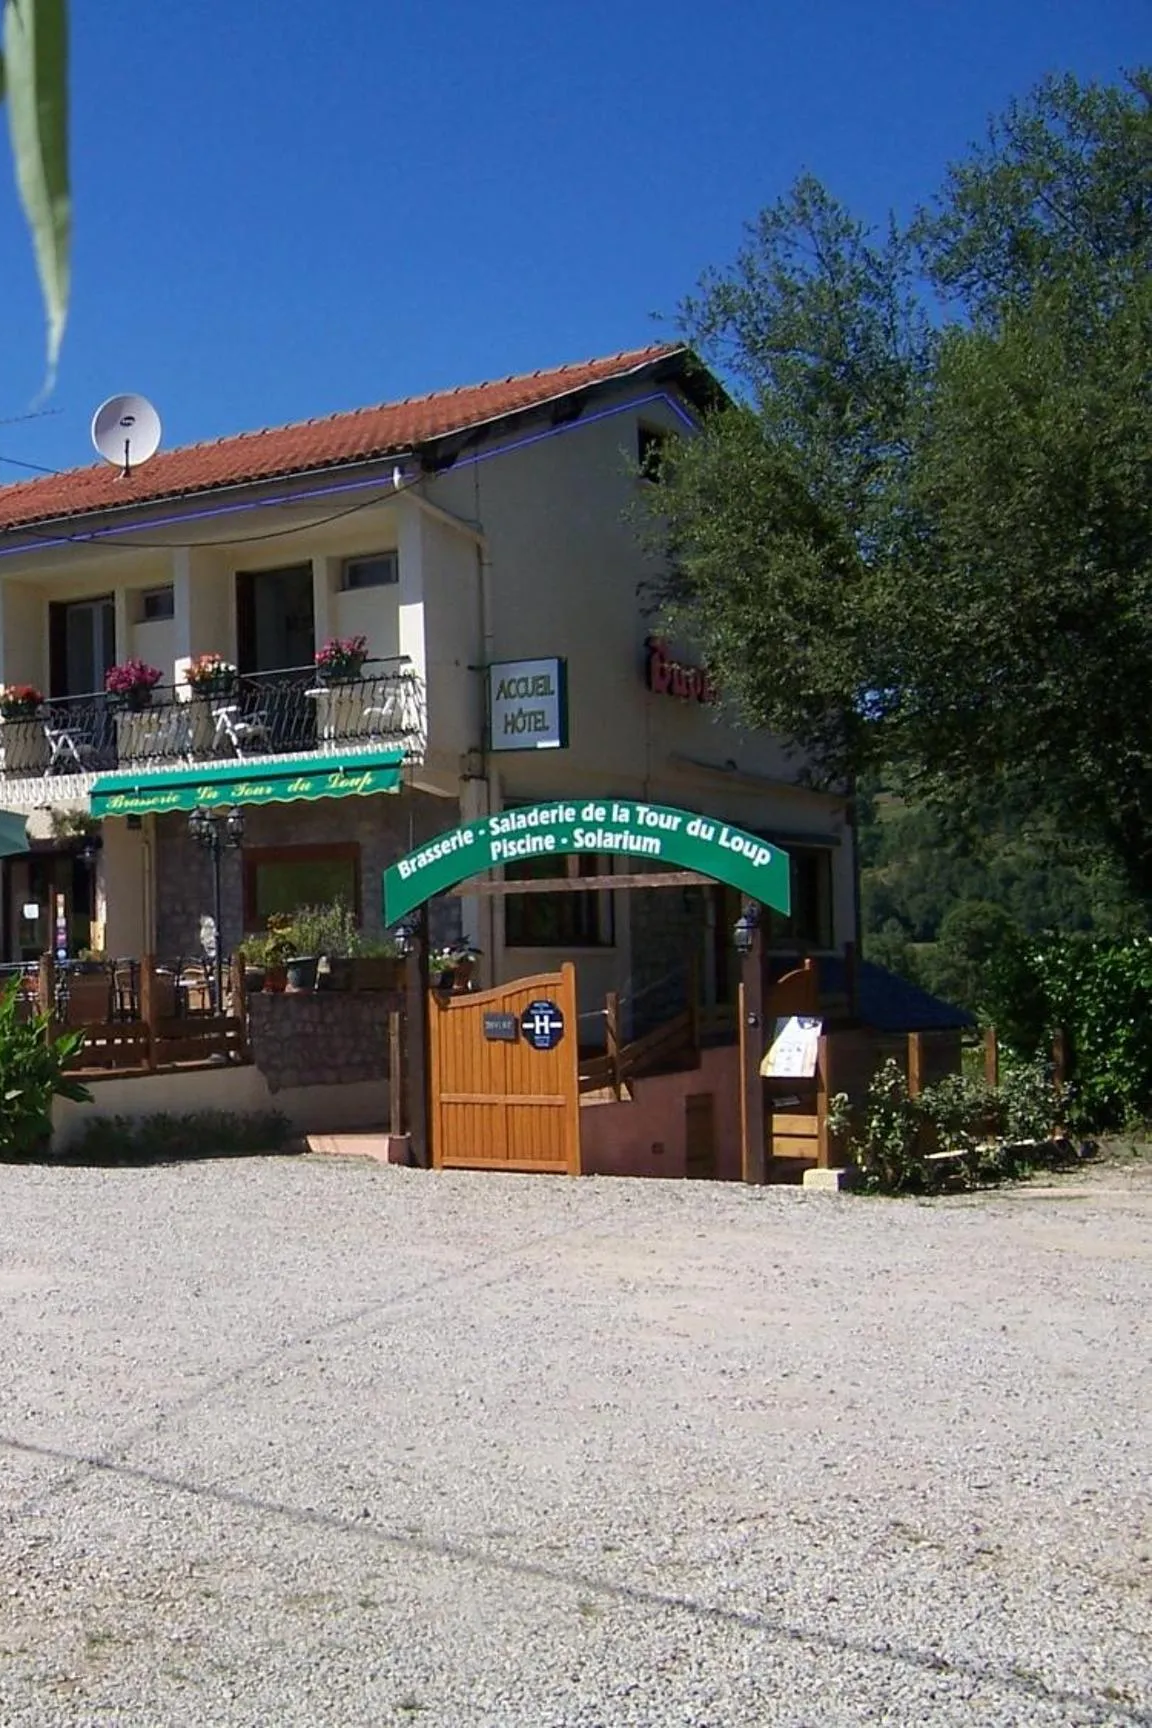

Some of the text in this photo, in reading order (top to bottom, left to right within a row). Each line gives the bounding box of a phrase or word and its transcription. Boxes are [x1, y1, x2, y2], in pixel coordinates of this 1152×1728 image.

[495, 674, 555, 700] ACCUEIL
[504, 706, 550, 734] HÔTEL
[105, 790, 181, 809] Brasserie
[230, 782, 273, 797] Tour
[287, 777, 312, 793] du
[327, 770, 373, 793] Loup
[397, 828, 475, 880] Brasserie
[488, 804, 576, 836] Saladerie
[581, 803, 606, 822] de
[612, 804, 630, 823] la
[635, 805, 683, 831] Tour
[686, 816, 715, 841] du
[718, 827, 772, 867] Loup
[490, 832, 556, 861] Piscine
[573, 828, 662, 855] Solarium
[534, 1014, 550, 1034] H
